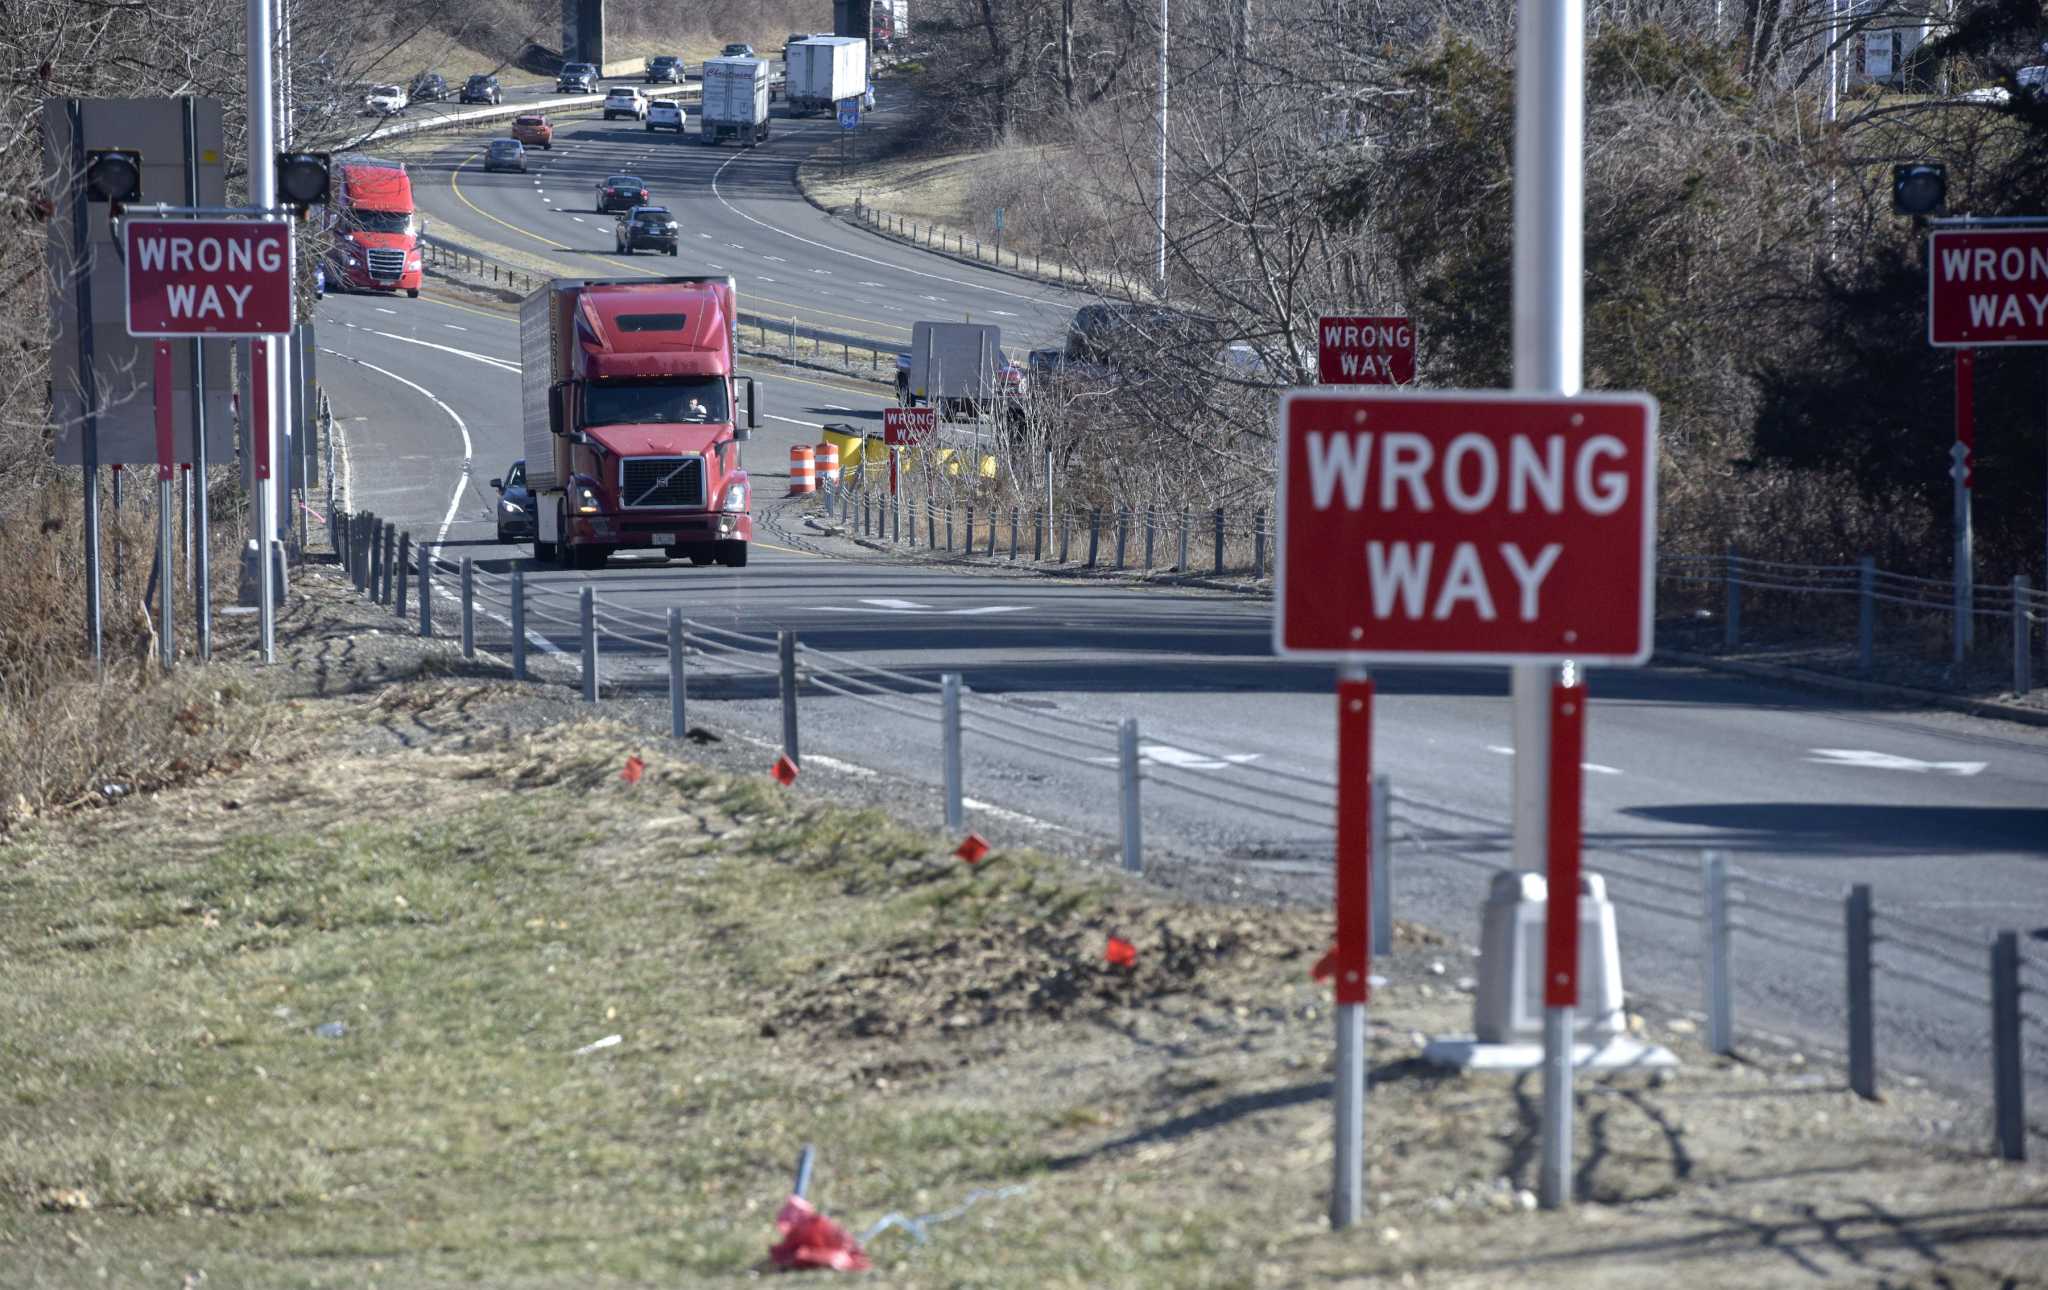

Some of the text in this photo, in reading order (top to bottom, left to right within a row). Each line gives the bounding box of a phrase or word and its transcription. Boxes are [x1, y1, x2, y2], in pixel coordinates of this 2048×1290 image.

[137, 237, 281, 273] WRONG
[1942, 247, 2048, 282] WRON
[166, 284, 253, 319] WAY
[1969, 294, 2048, 328] WAY
[1324, 325, 1410, 348] WRONG
[1341, 355, 1393, 376] WAY
[887, 413, 935, 425] WRONG
[1306, 431, 1630, 516] WRONG
[1366, 541, 1563, 622] WAY
